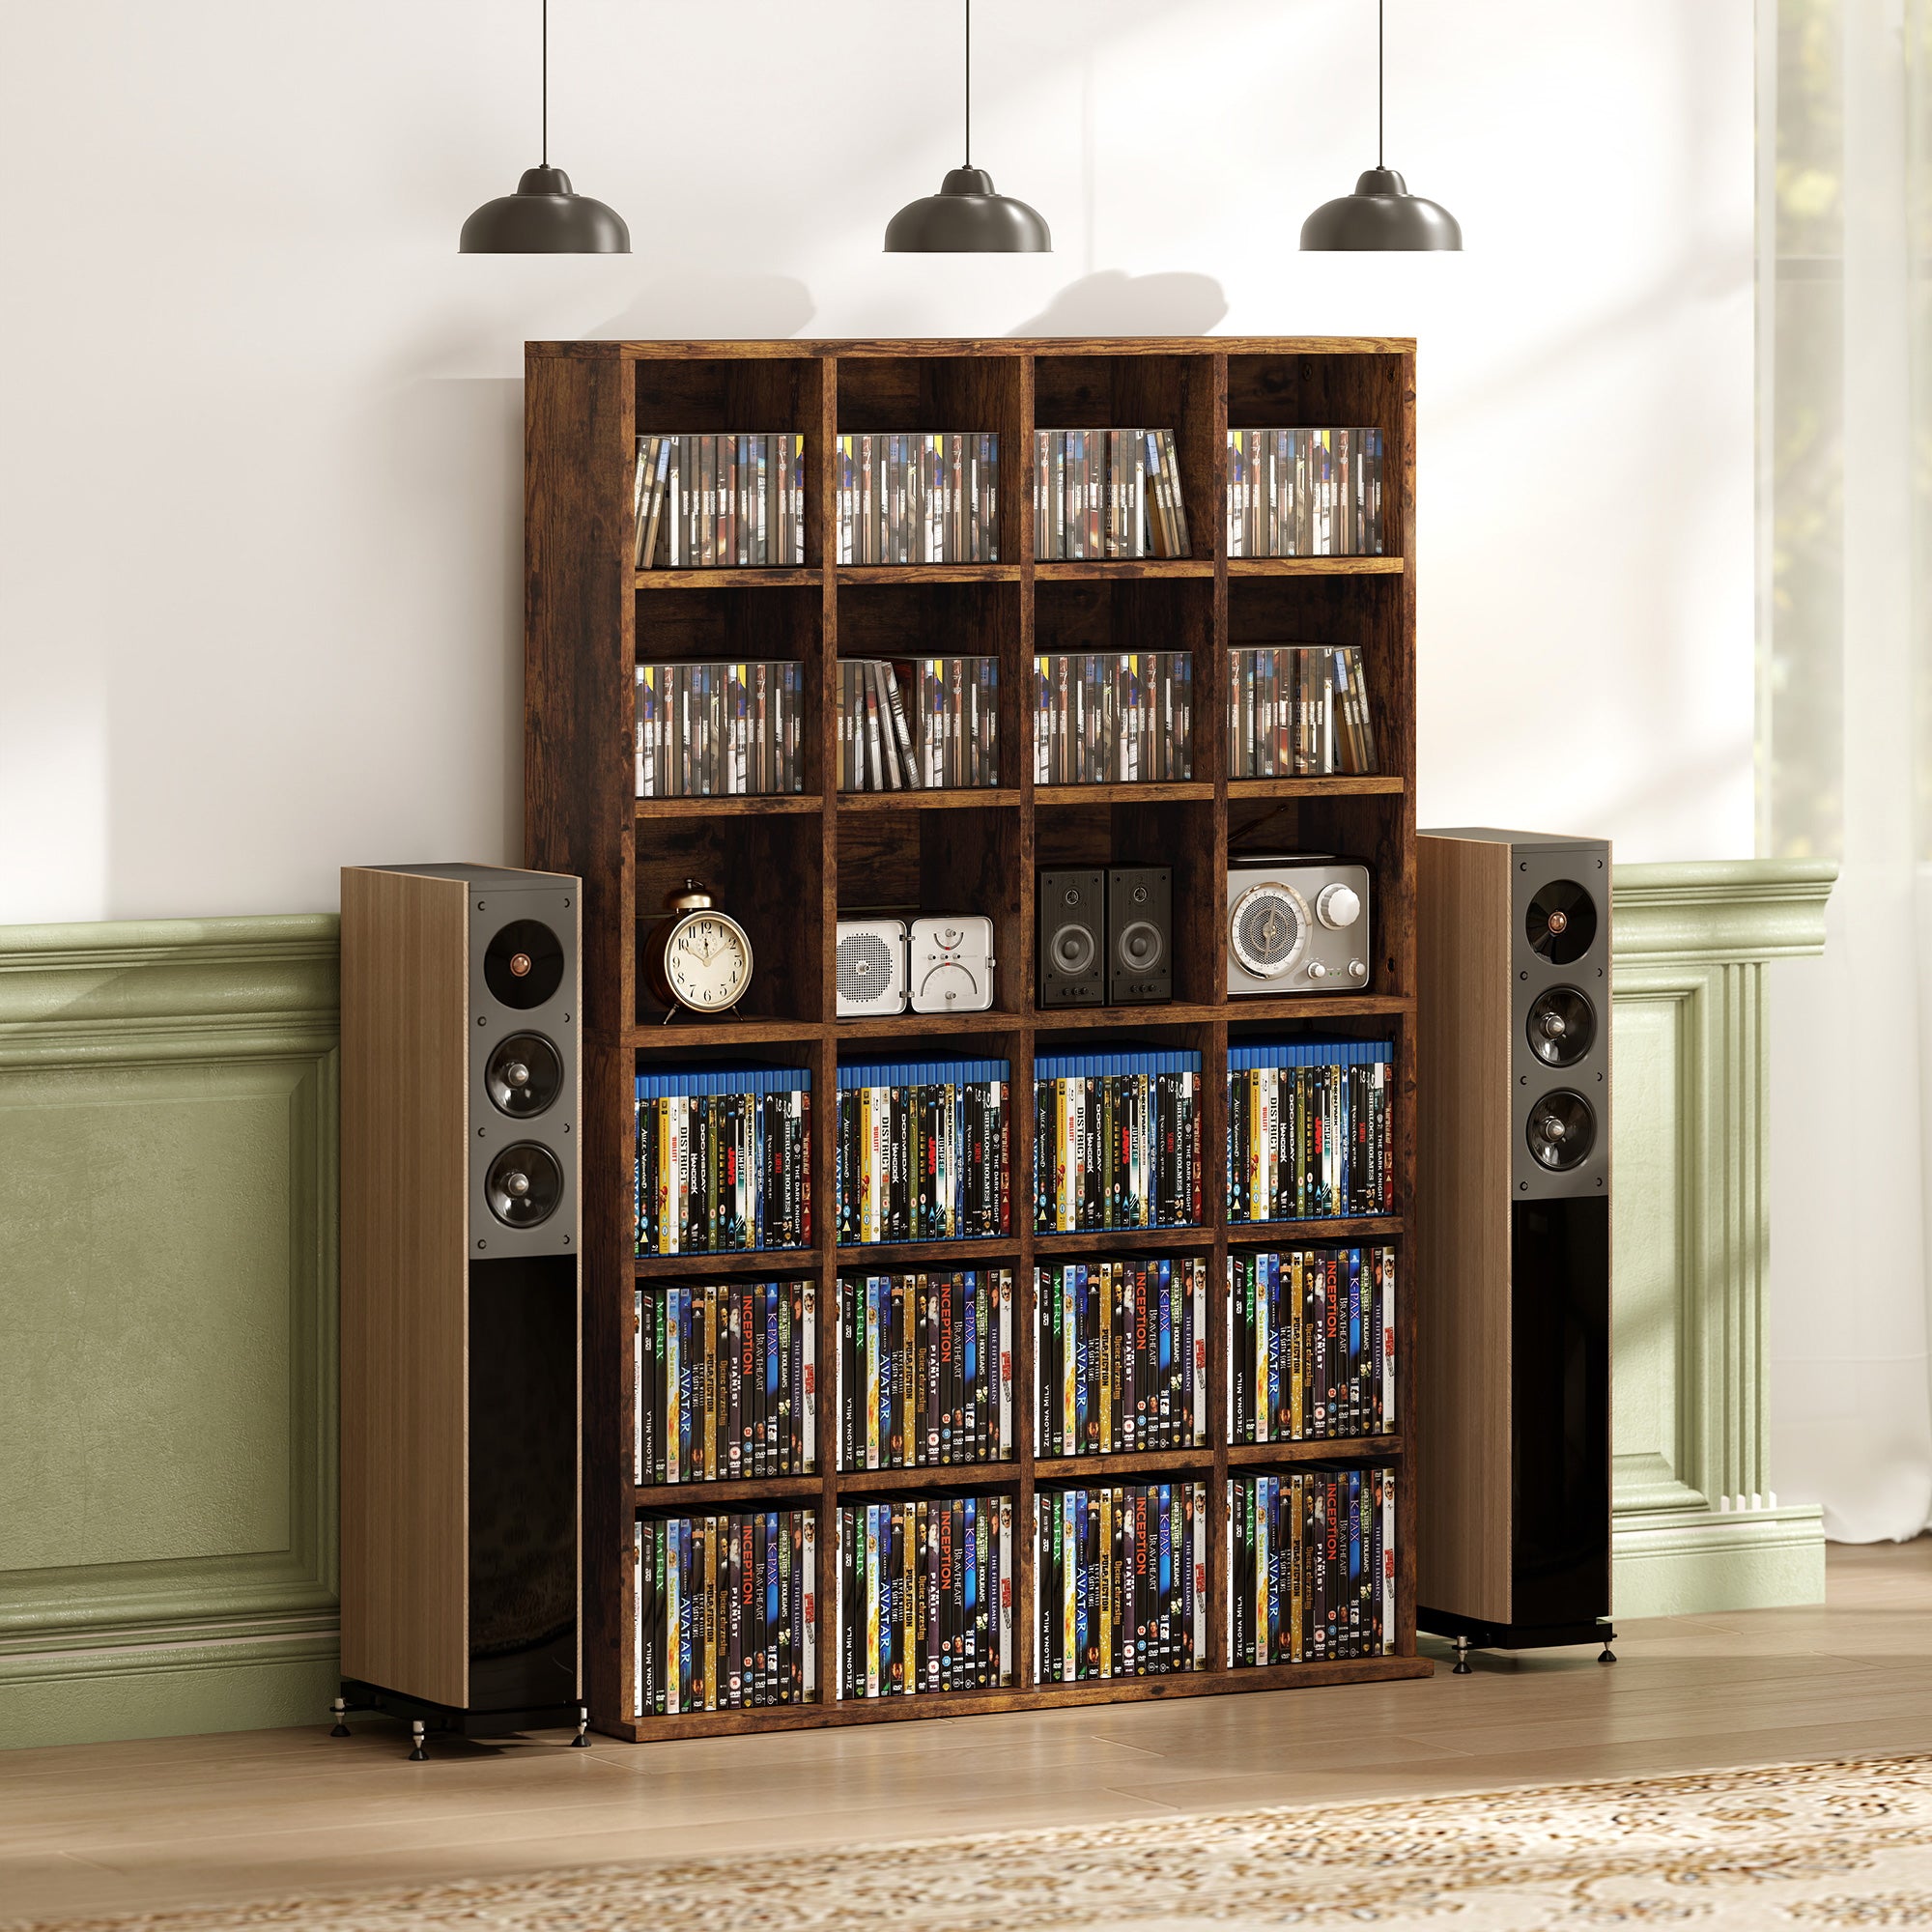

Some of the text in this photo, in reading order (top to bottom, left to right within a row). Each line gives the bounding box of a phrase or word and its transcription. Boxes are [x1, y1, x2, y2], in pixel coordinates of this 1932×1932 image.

[678, 939, 689, 951] 10
[689, 925, 696, 939] 11
[701, 922, 711, 934] 12
[728, 938, 736, 950] 2
[672, 956, 680, 968] 9
[677, 972, 685, 984] 8
[720, 983, 727, 996] 5
[729, 971, 738, 983] 4
[734, 954, 742, 968] 3
[689, 984, 696, 997] 7
[703, 989, 711, 1002] 6
[941, 1284, 951, 1362] INCEPTION
[965, 1301, 975, 1345] K-PAX
[1136, 1272, 1146, 1350] INCEPTION
[1160, 1289, 1169, 1332] K-PAX
[1327, 1261, 1336, 1338] INCEPTION
[1339, 1297, 1348, 1354] BRAVEHEART
[1350, 1277, 1359, 1321] K-PAX
[743, 1295, 753, 1375] INCEPTION
[755, 1333, 764, 1392] BRAVEHEART
[767, 1313, 777, 1357] K-PAX
[953, 1321, 962, 1378] BRAVEHEART
[1149, 1309, 1157, 1366] BRAVEHEART
[1268, 1330, 1279, 1395] AVATAR
[680, 1367, 691, 1434] AVATAR
[880, 1354, 890, 1420] AVATAR
[1076, 1342, 1087, 1407] AVATAR
[1136, 1497, 1146, 1575] INCEPTION
[1160, 1514, 1169, 1557] K-PAX
[1327, 1484, 1336, 1560] INCEPTION
[1339, 1520, 1348, 1577] BRAVEHEART
[1350, 1499, 1359, 1543] K-PAX
[743, 1525, 753, 1605] INCEPTION
[767, 1542, 777, 1586] K-PAX
[941, 1511, 951, 1590] INCEPTION
[953, 1548, 962, 1606] BRAVEHEART
[965, 1528, 975, 1572] K-PAX
[1149, 1534, 1157, 1591] BRAVEHEART
[755, 1563, 765, 1621] BRAVEHEART
[1076, 1568, 1087, 1633] AVATAR
[1268, 1553, 1278, 1618] AVATAR
[680, 1598, 691, 1664] AVATAR
[880, 1582, 890, 1649] AVATAR
